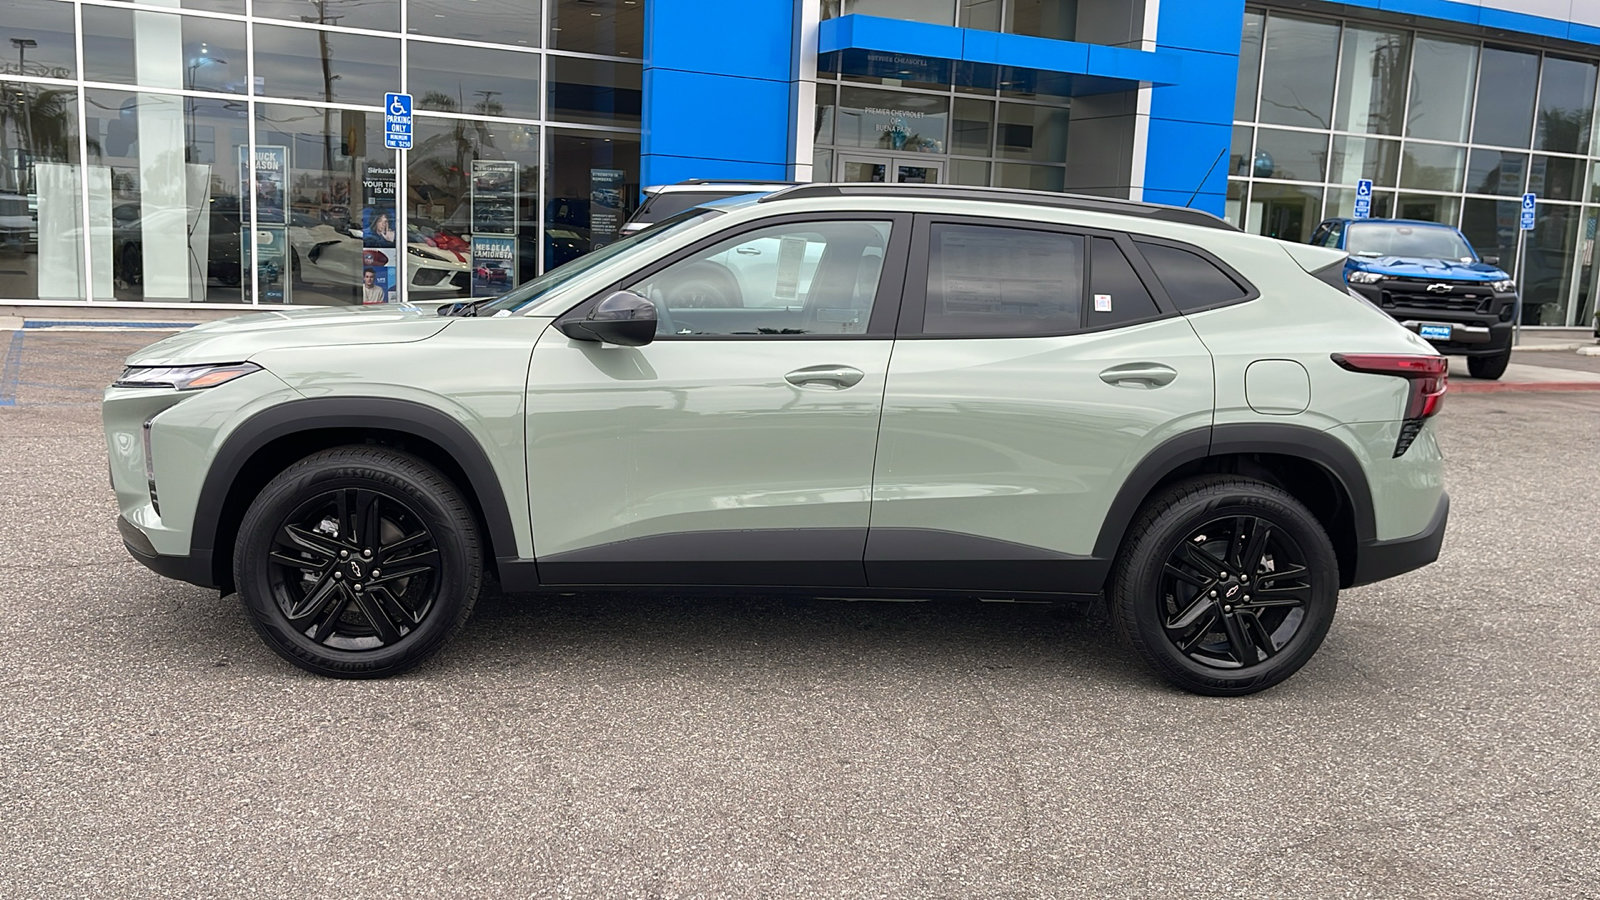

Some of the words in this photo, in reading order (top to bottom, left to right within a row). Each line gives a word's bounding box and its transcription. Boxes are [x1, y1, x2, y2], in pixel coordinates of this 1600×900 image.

[864, 107, 890, 116] PREMIER
[890, 109, 925, 119] CHEVROLET
[387, 115, 410, 125] PARKING
[391, 124, 406, 132] ONLY
[875, 124, 896, 132] BUENA
[255, 152, 276, 161] RUCK
[245, 160, 279, 170] SASON
[475, 243, 490, 251] MES
[474, 251, 513, 259] CAMIONETA
[336, 468, 424, 501] ASSURANCE
